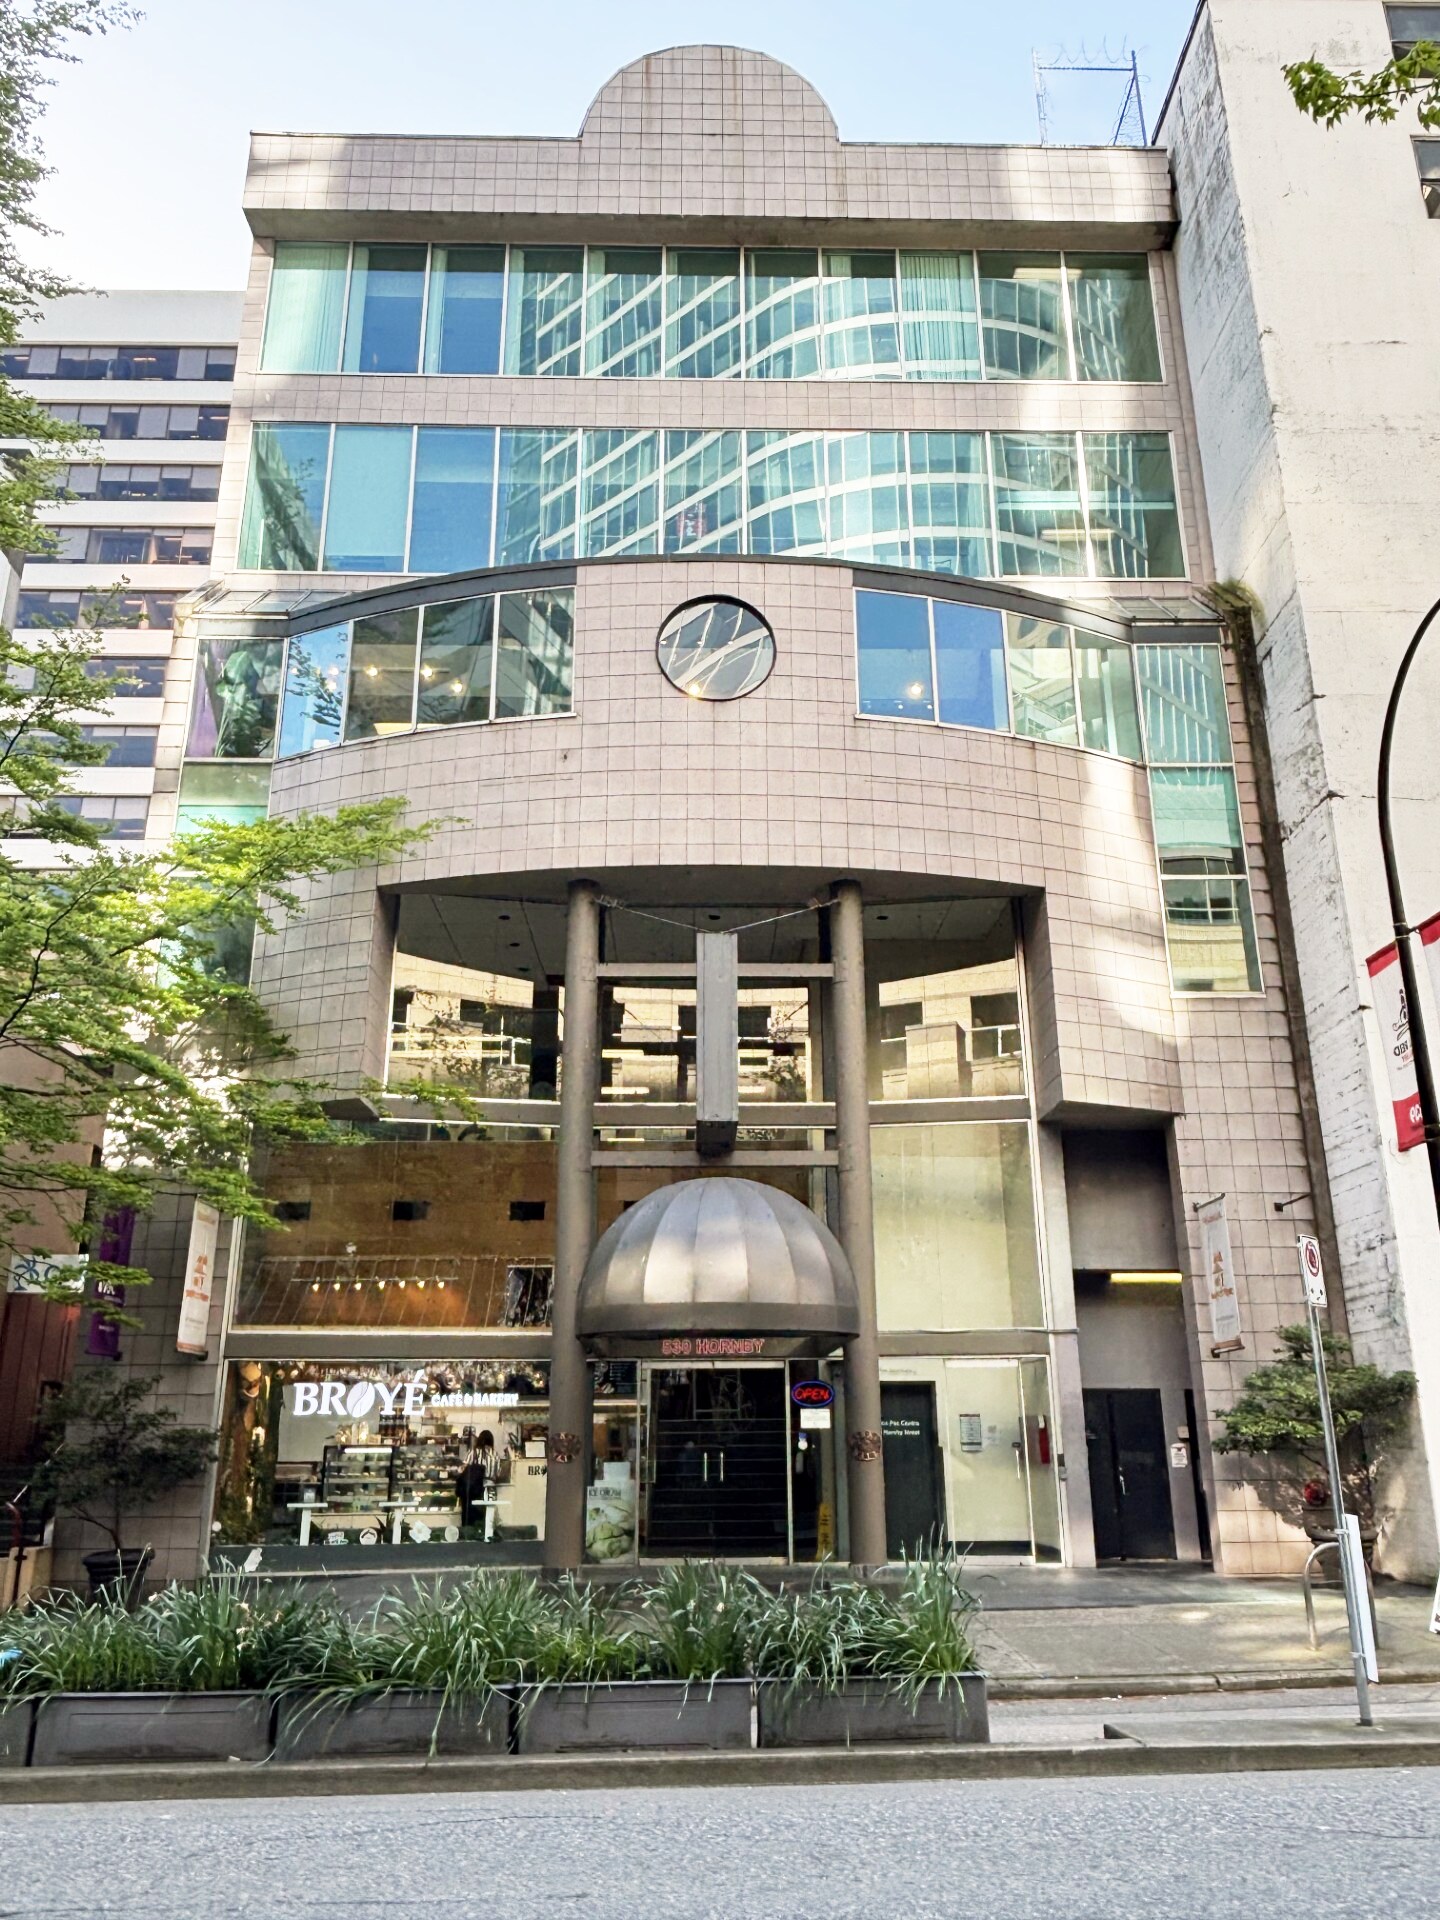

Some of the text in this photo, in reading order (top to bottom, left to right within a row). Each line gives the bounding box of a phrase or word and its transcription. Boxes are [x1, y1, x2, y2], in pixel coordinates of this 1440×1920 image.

[662, 1338, 765, 1354] 530 HORNBY
[431, 1389, 463, 1407] CAFÉ
[473, 1391, 519, 1406] BAKERY
[795, 1387, 829, 1400] OPEN
